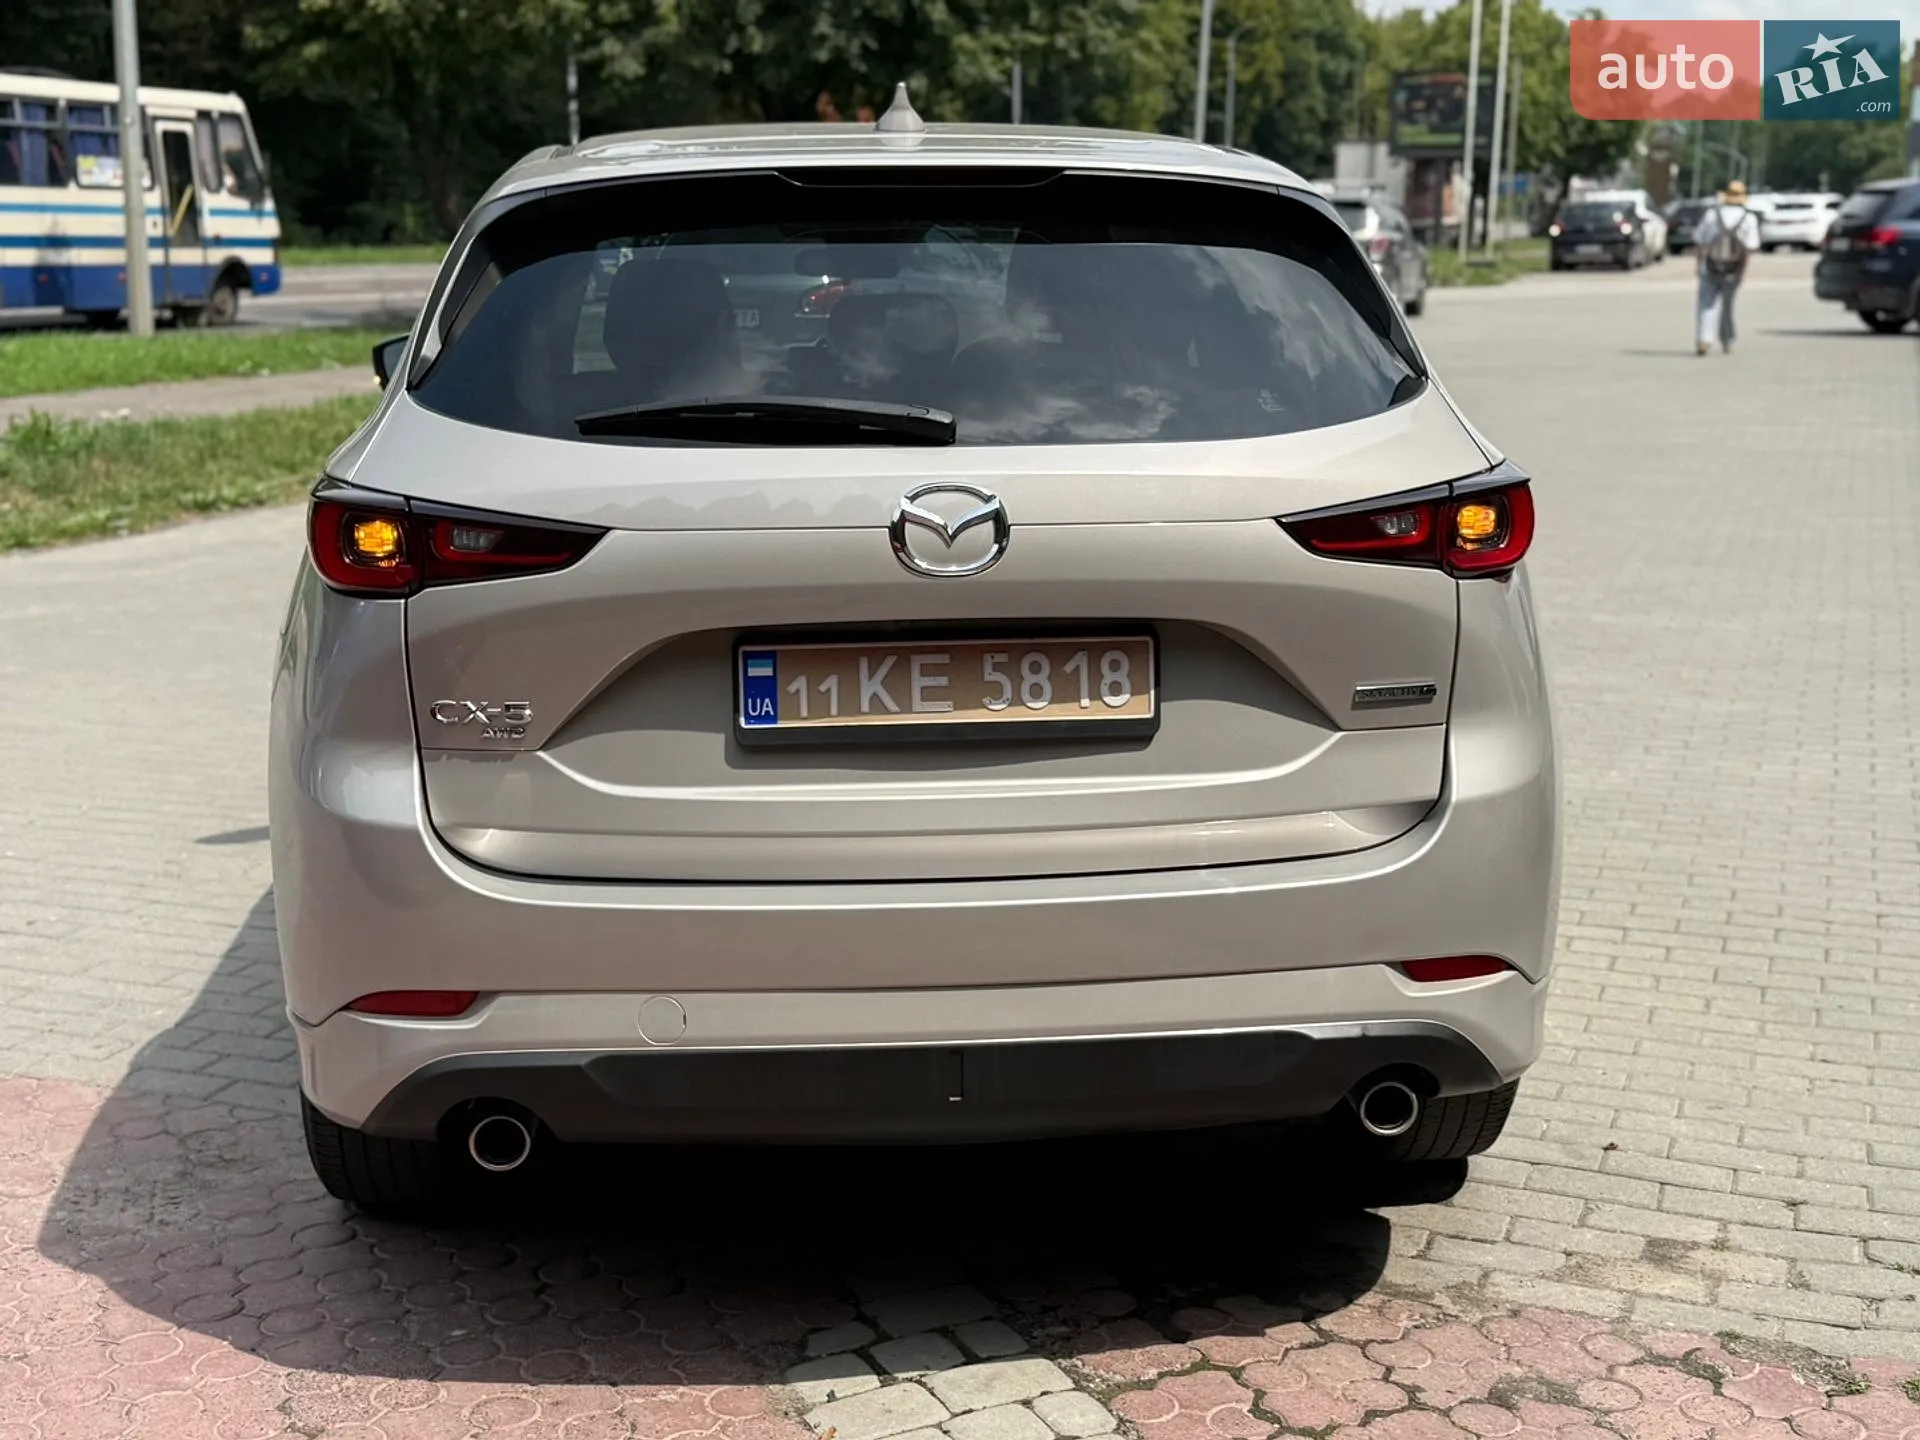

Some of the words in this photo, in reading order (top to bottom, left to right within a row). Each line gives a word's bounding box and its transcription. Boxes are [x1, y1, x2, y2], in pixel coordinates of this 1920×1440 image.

[786, 674, 838, 719] 11
[858, 653, 954, 714] KE
[981, 650, 1132, 711] 5818
[430, 699, 534, 724] CX-5
[748, 698, 774, 716] UA
[480, 727, 526, 739] AWD
